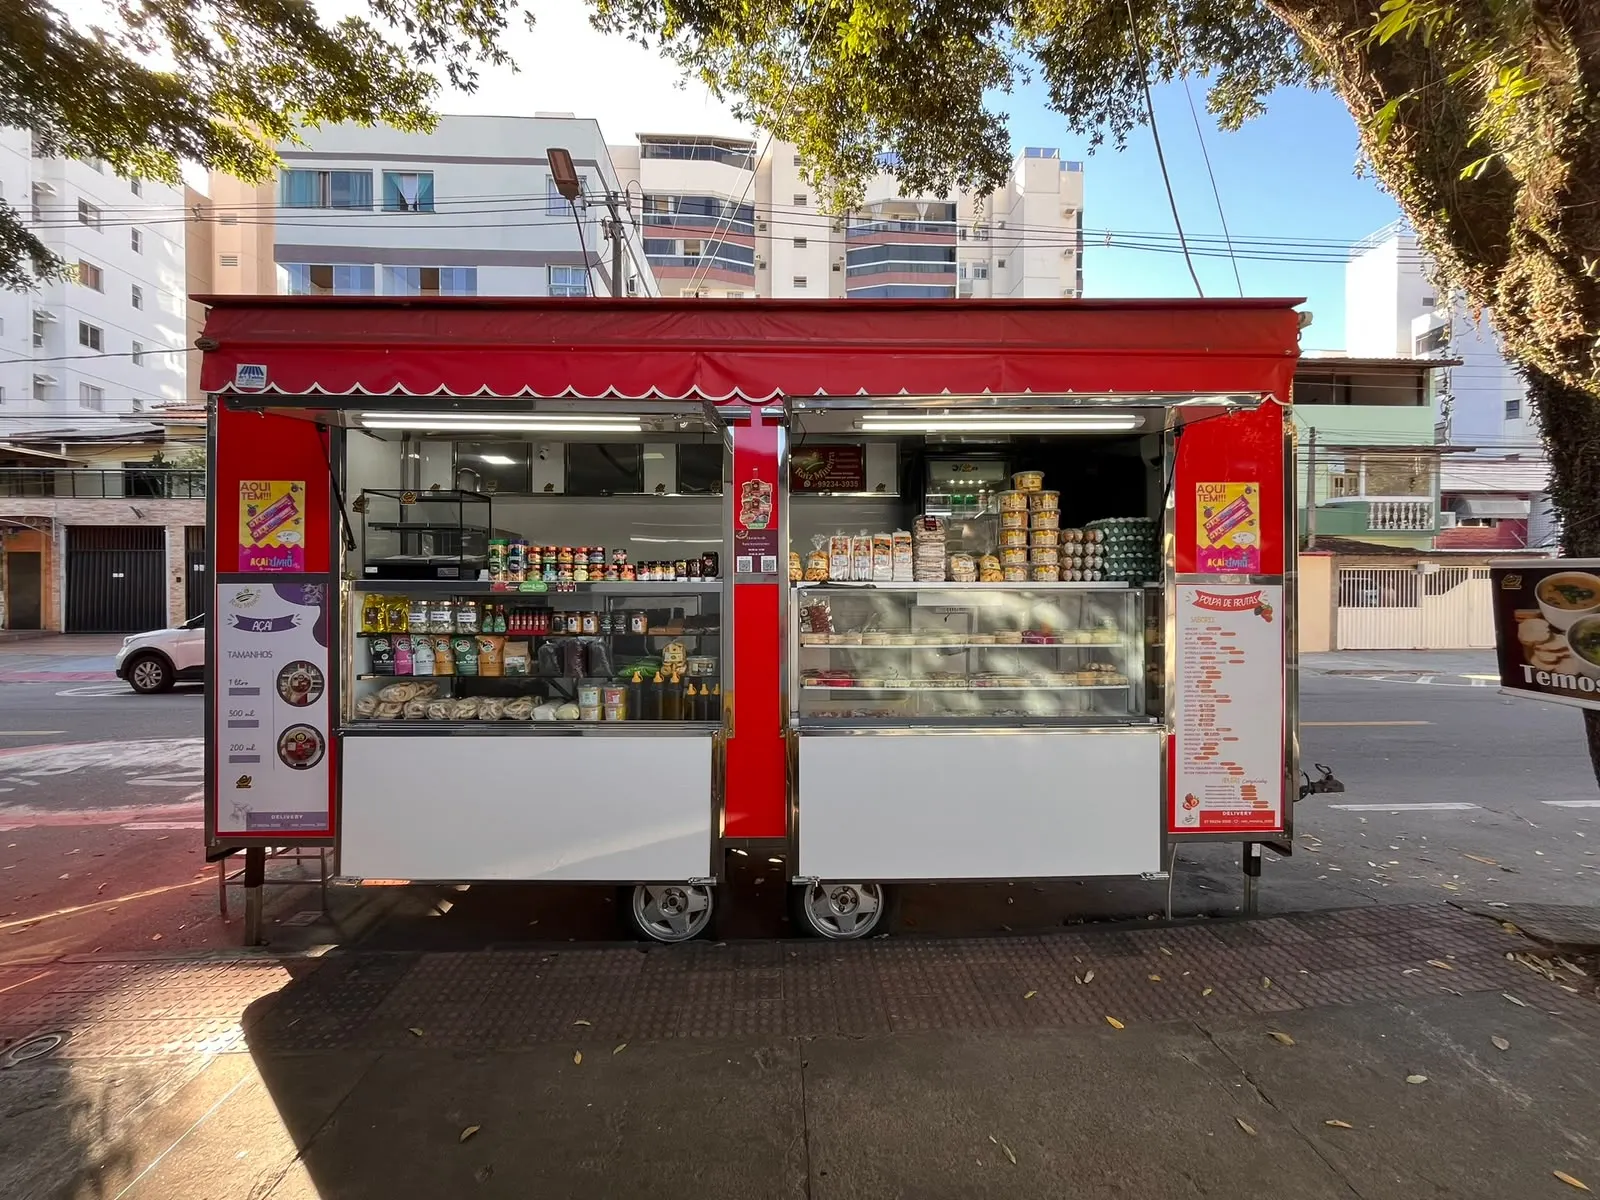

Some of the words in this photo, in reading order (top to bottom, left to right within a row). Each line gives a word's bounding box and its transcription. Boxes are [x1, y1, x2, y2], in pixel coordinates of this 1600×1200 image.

[240, 482, 271, 492] AQUI
[1197, 484, 1226, 494] AQUI
[241, 492, 272, 500] TEM!!!
[1198, 494, 1227, 502] TEM!!!
[1199, 595, 1222, 606] POLPA
[1222, 598, 1232, 607] DE
[1233, 596, 1258, 606] FRUTAS
[228, 650, 272, 658] TAMANHOS
[230, 744, 244, 752] 200
